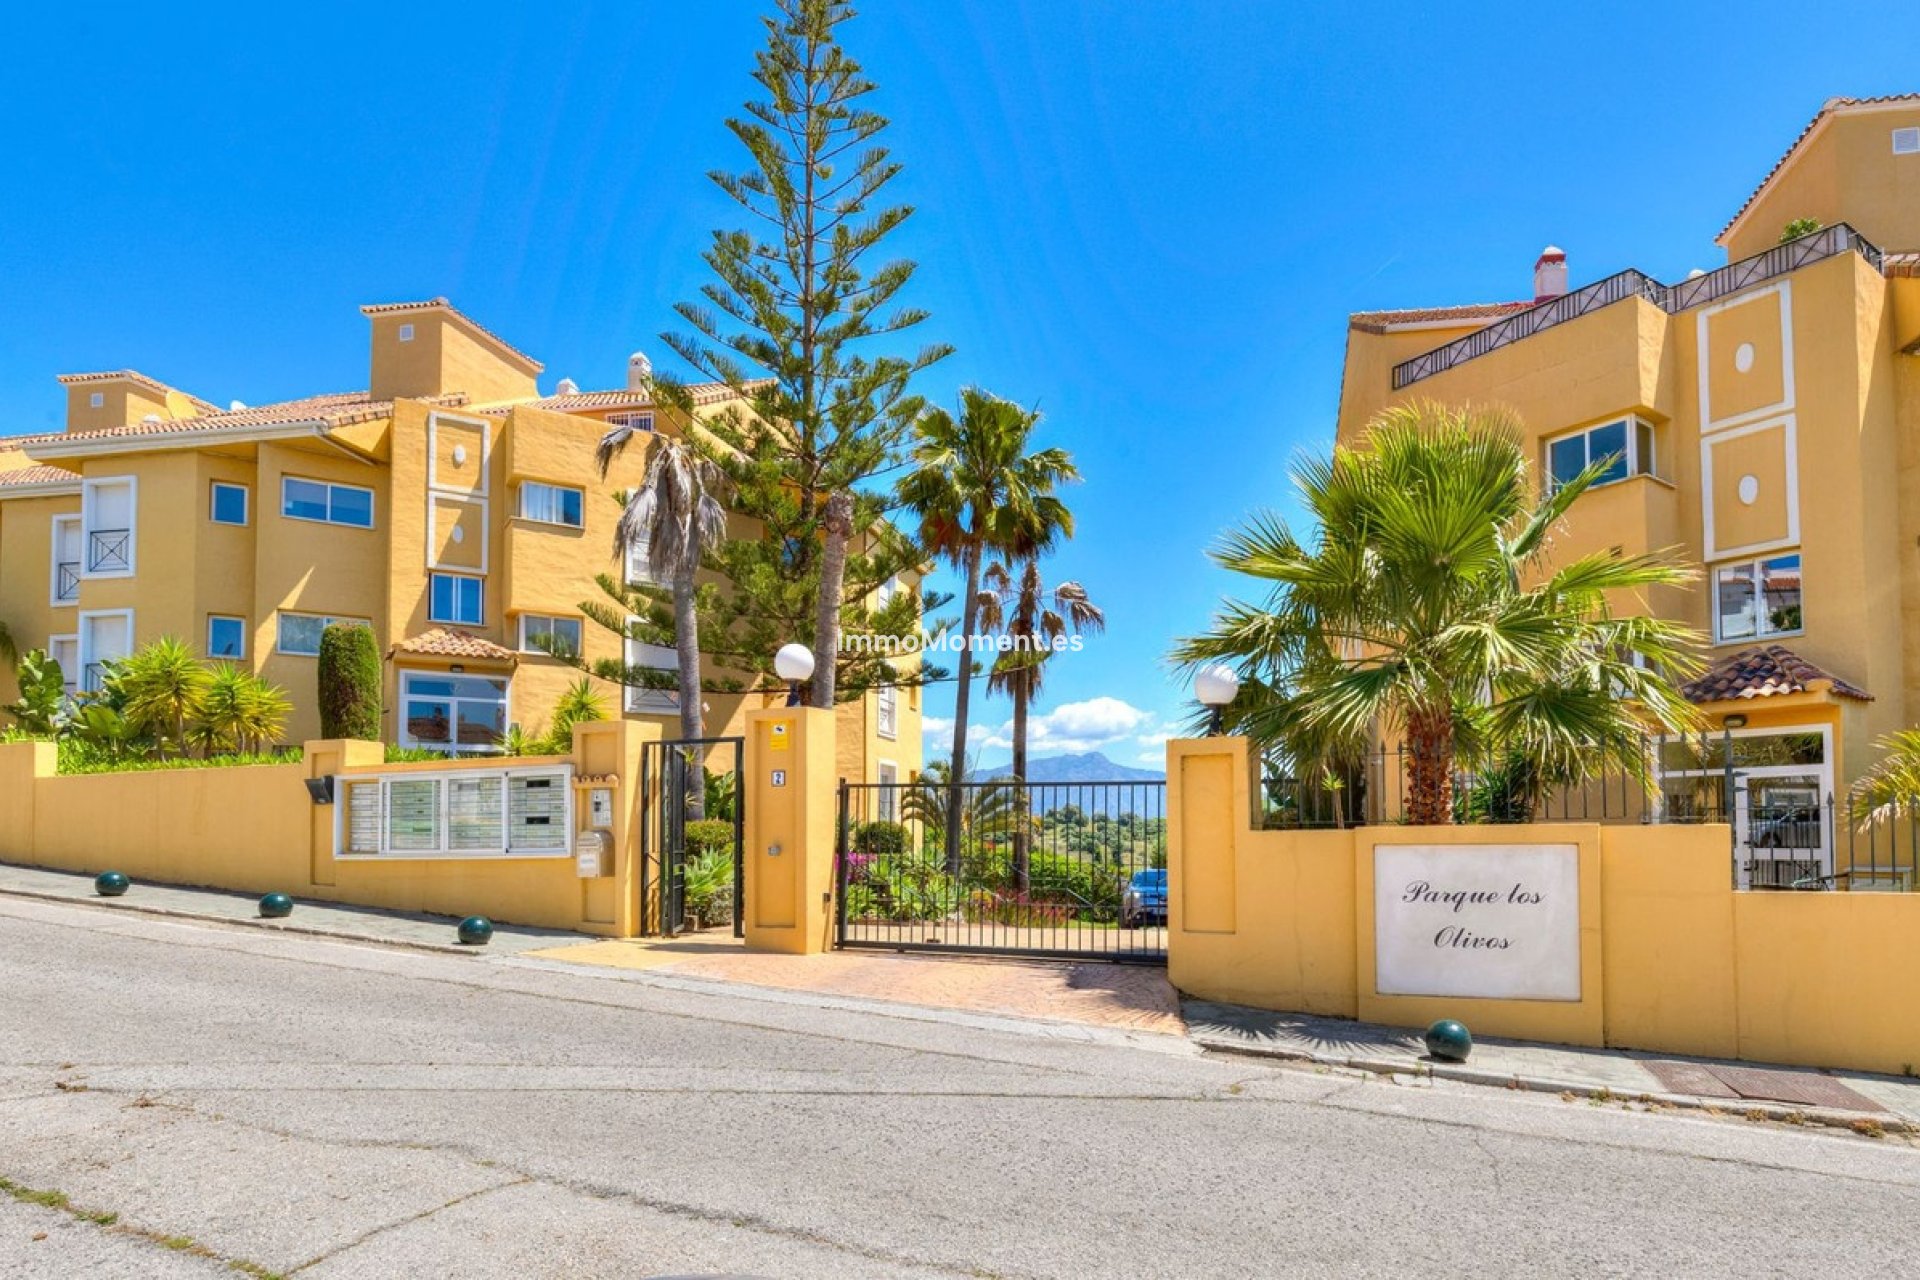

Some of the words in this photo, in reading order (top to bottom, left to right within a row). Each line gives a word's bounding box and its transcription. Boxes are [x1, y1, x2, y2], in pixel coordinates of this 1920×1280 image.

[1402, 880, 1500, 912] Parque
[1507, 883, 1546, 904] los
[1434, 925, 1516, 950] Olivos
